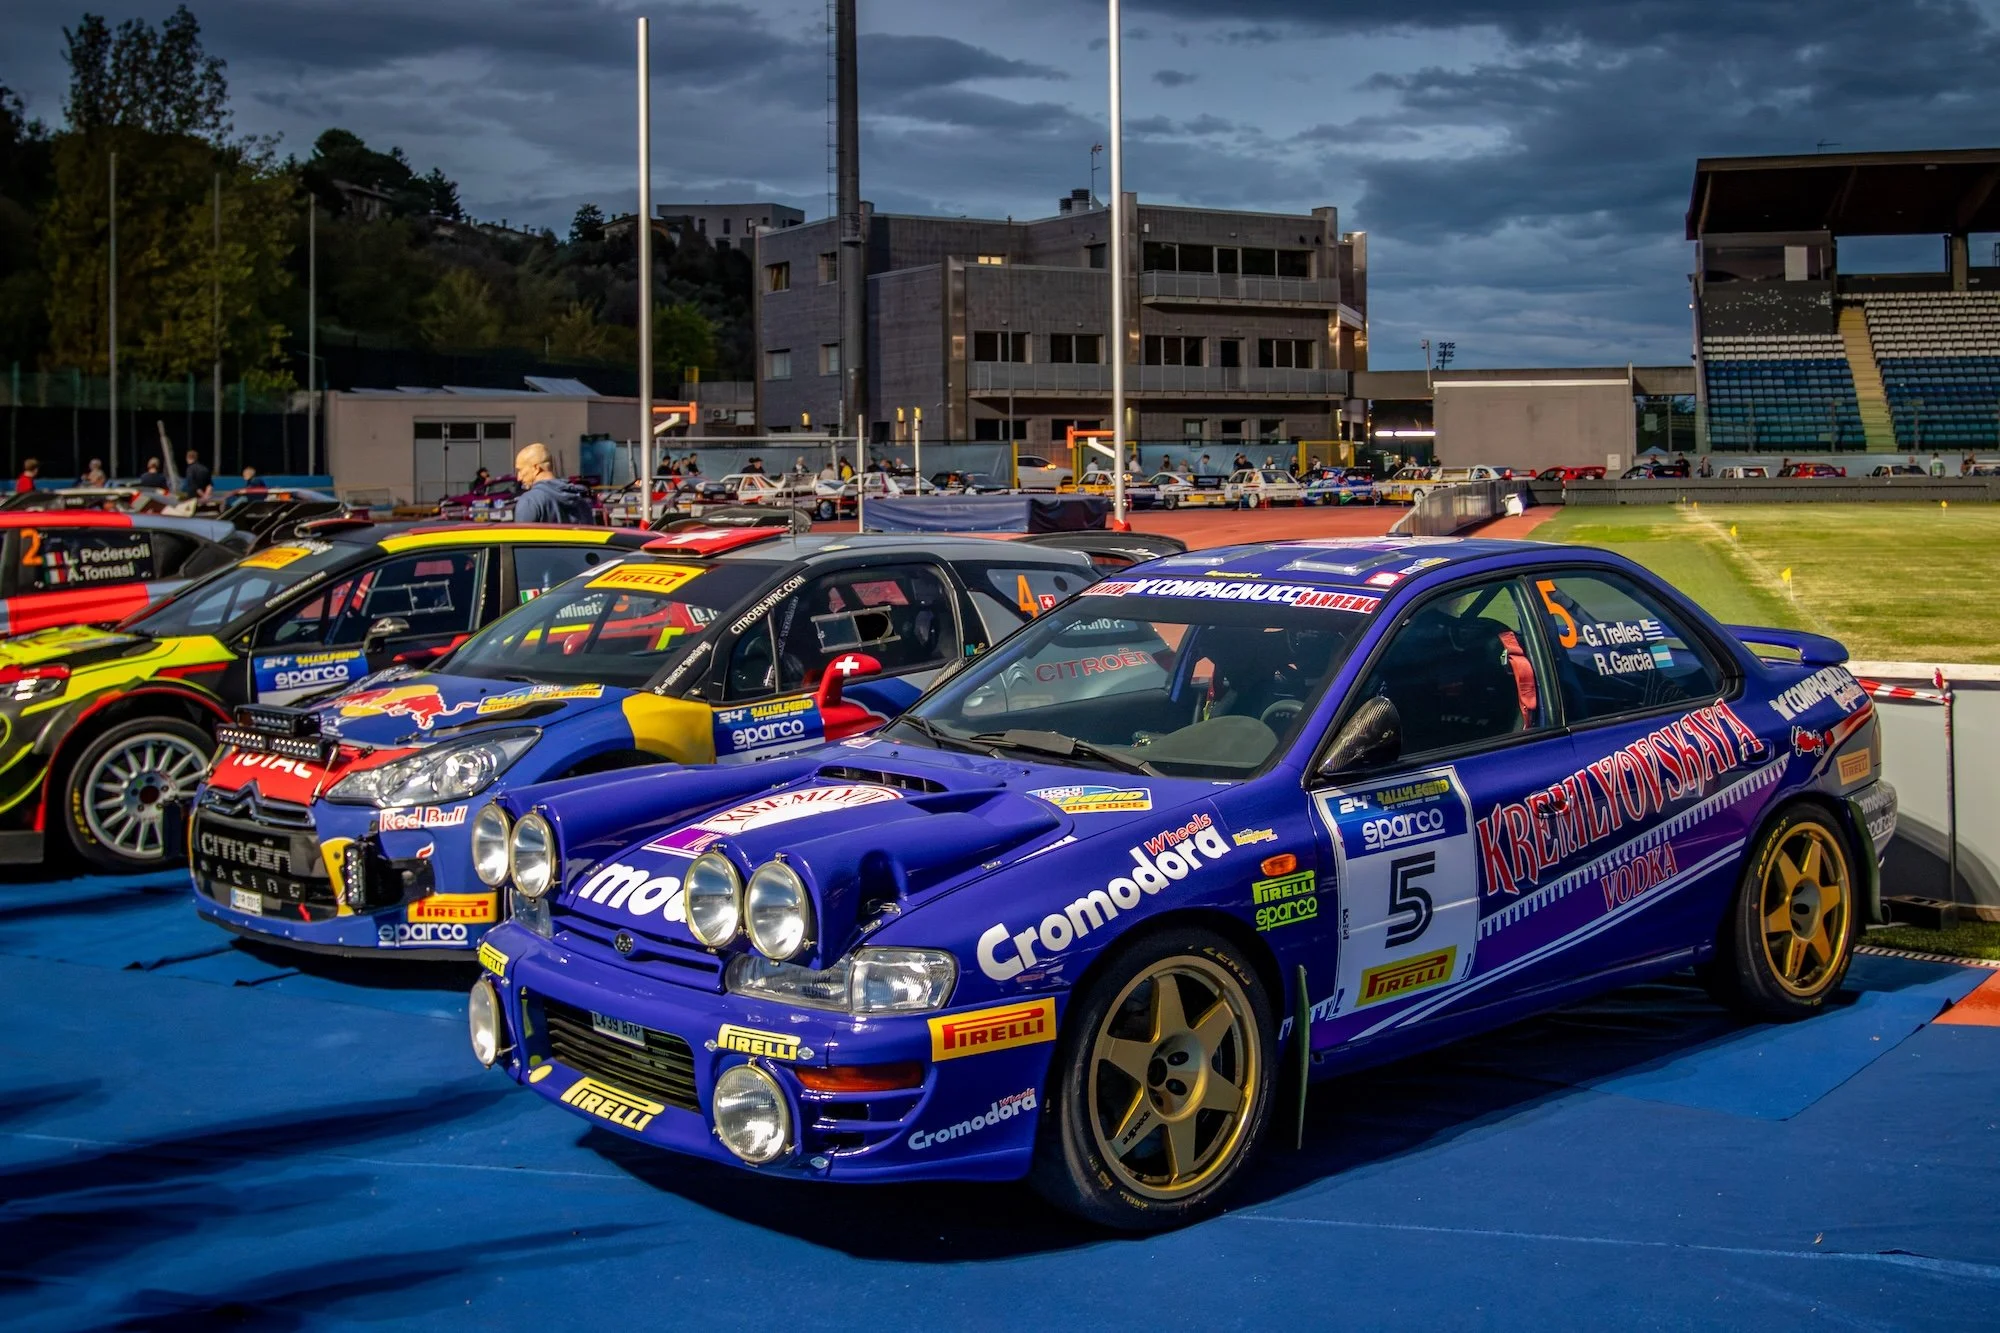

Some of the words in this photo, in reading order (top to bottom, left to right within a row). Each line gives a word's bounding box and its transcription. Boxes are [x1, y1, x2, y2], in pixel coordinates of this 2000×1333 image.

[20, 528, 43, 566] 2
[64, 551, 79, 565] L.
[81, 543, 151, 563] Pedersoli
[601, 569, 687, 587] PIRELLI
[730, 575, 807, 635] CITROEN-WRC.COM
[1017, 574, 1040, 618] 4
[1295, 591, 1382, 613] SANREMO
[1536, 580, 1578, 649] 5
[1582, 621, 1644, 647] G.Trelles
[275, 664, 349, 689] sparco
[1593, 648, 1655, 676] R.Garcia
[750, 699, 814, 718] RALLYLEGEND
[732, 719, 805, 750] sparco
[1840, 754, 1869, 780] PIRELLI
[1376, 779, 1450, 805] RALLYLEGEND
[1476, 698, 1764, 896] KREMLYOVSKAYA
[380, 807, 421, 832] Red
[424, 805, 469, 828] Bull
[1144, 812, 1212, 856] Wheels
[1362, 808, 1446, 850] sparco
[1252, 870, 1316, 905] PIRELLI
[1600, 843, 1679, 912] VODKA
[417, 900, 489, 918] PIRELLI
[976, 825, 1232, 982] Cromodora
[1256, 896, 1318, 931] sparco
[1384, 850, 1436, 950] 5
[378, 923, 468, 947] sparco
[1365, 954, 1449, 1000] PIRELLI
[718, 1023, 801, 1061] PIRELLI
[942, 1007, 1045, 1051] PIRELLI
[560, 1076, 665, 1132] PIRELLI
[998, 1087, 1036, 1108] Wheels
[907, 1094, 1037, 1151] Cromodora
